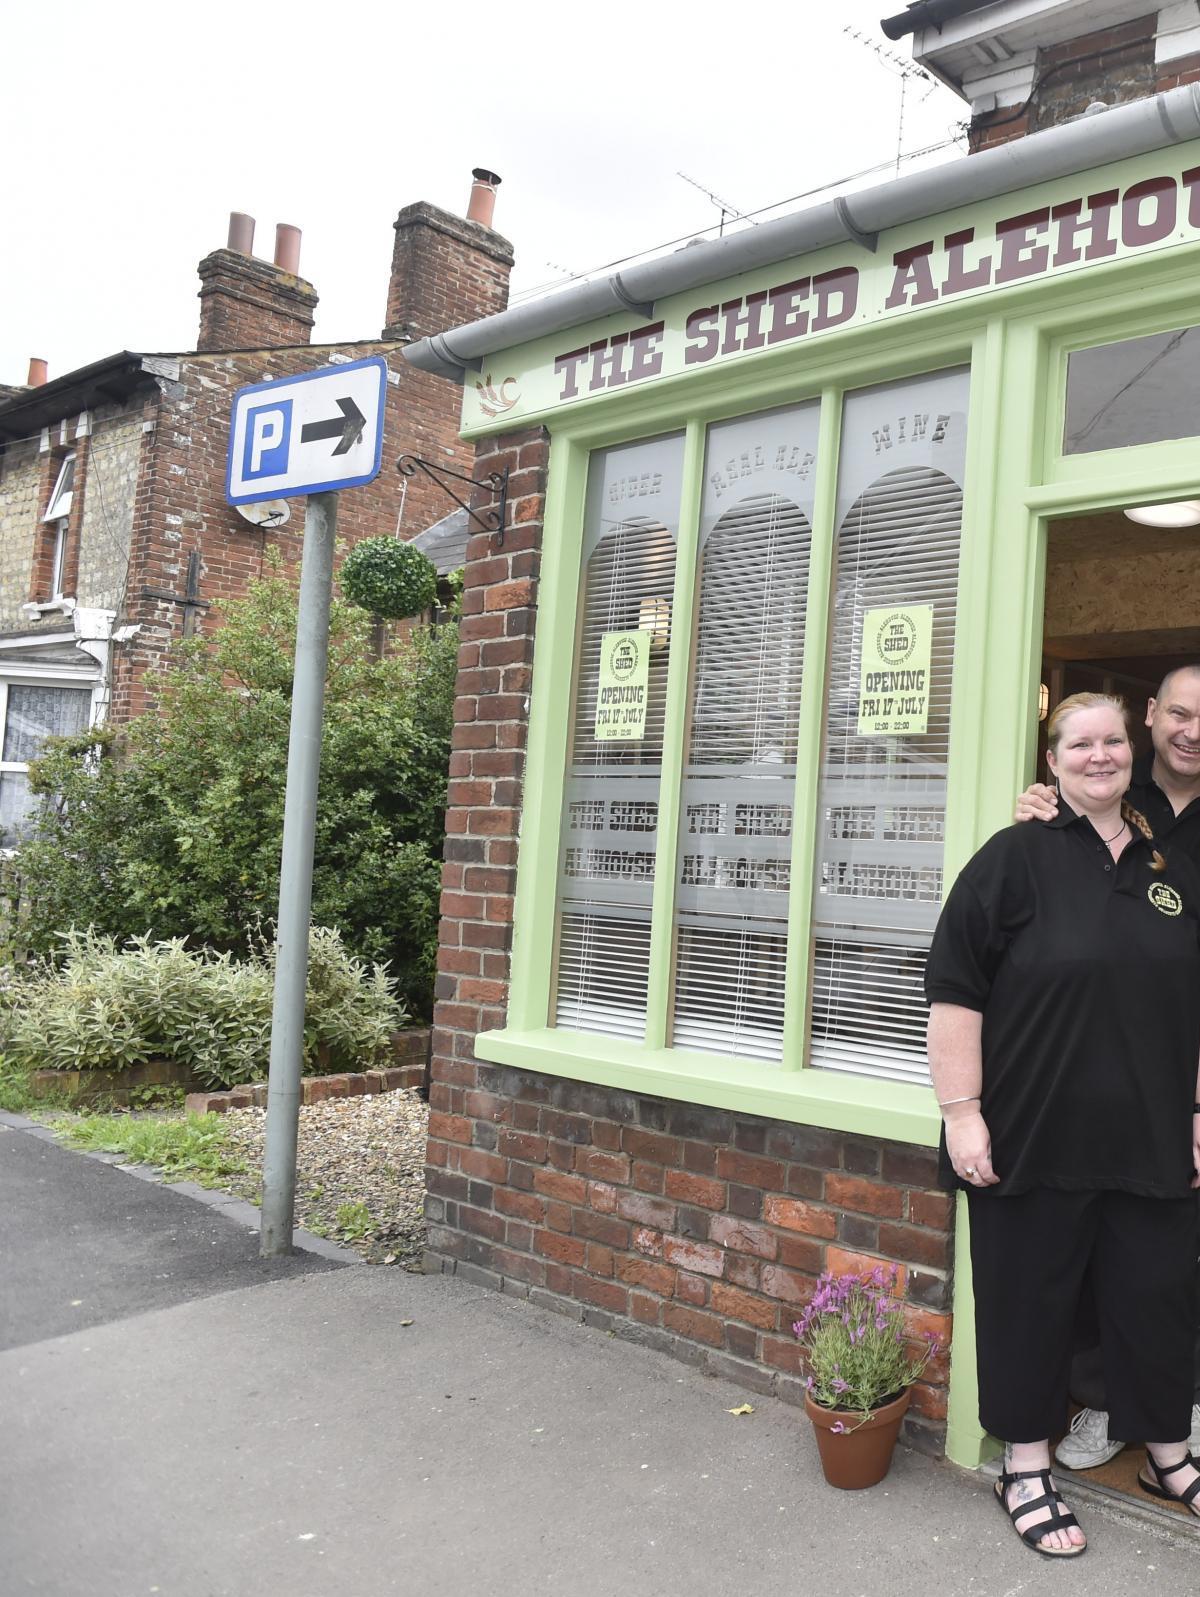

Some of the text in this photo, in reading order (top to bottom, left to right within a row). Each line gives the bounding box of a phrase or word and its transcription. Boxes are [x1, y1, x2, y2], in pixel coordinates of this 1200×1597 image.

[554, 320, 665, 400] THE
[684, 266, 860, 365] SHED
[250, 409, 285, 473] P
[872, 414, 950, 455] WINE
[889, 624, 904, 635] THE
[884, 637, 909, 652] SHED
[615, 657, 633, 670] SHED
[866, 670, 925, 693] OPENING
[601, 685, 644, 704] OPENING
[597, 708, 611, 724] FRI
[623, 707, 644, 724] JULY
[862, 698, 881, 717] FRI
[897, 697, 926, 715] JULY
[568, 800, 658, 832] THE SHED
